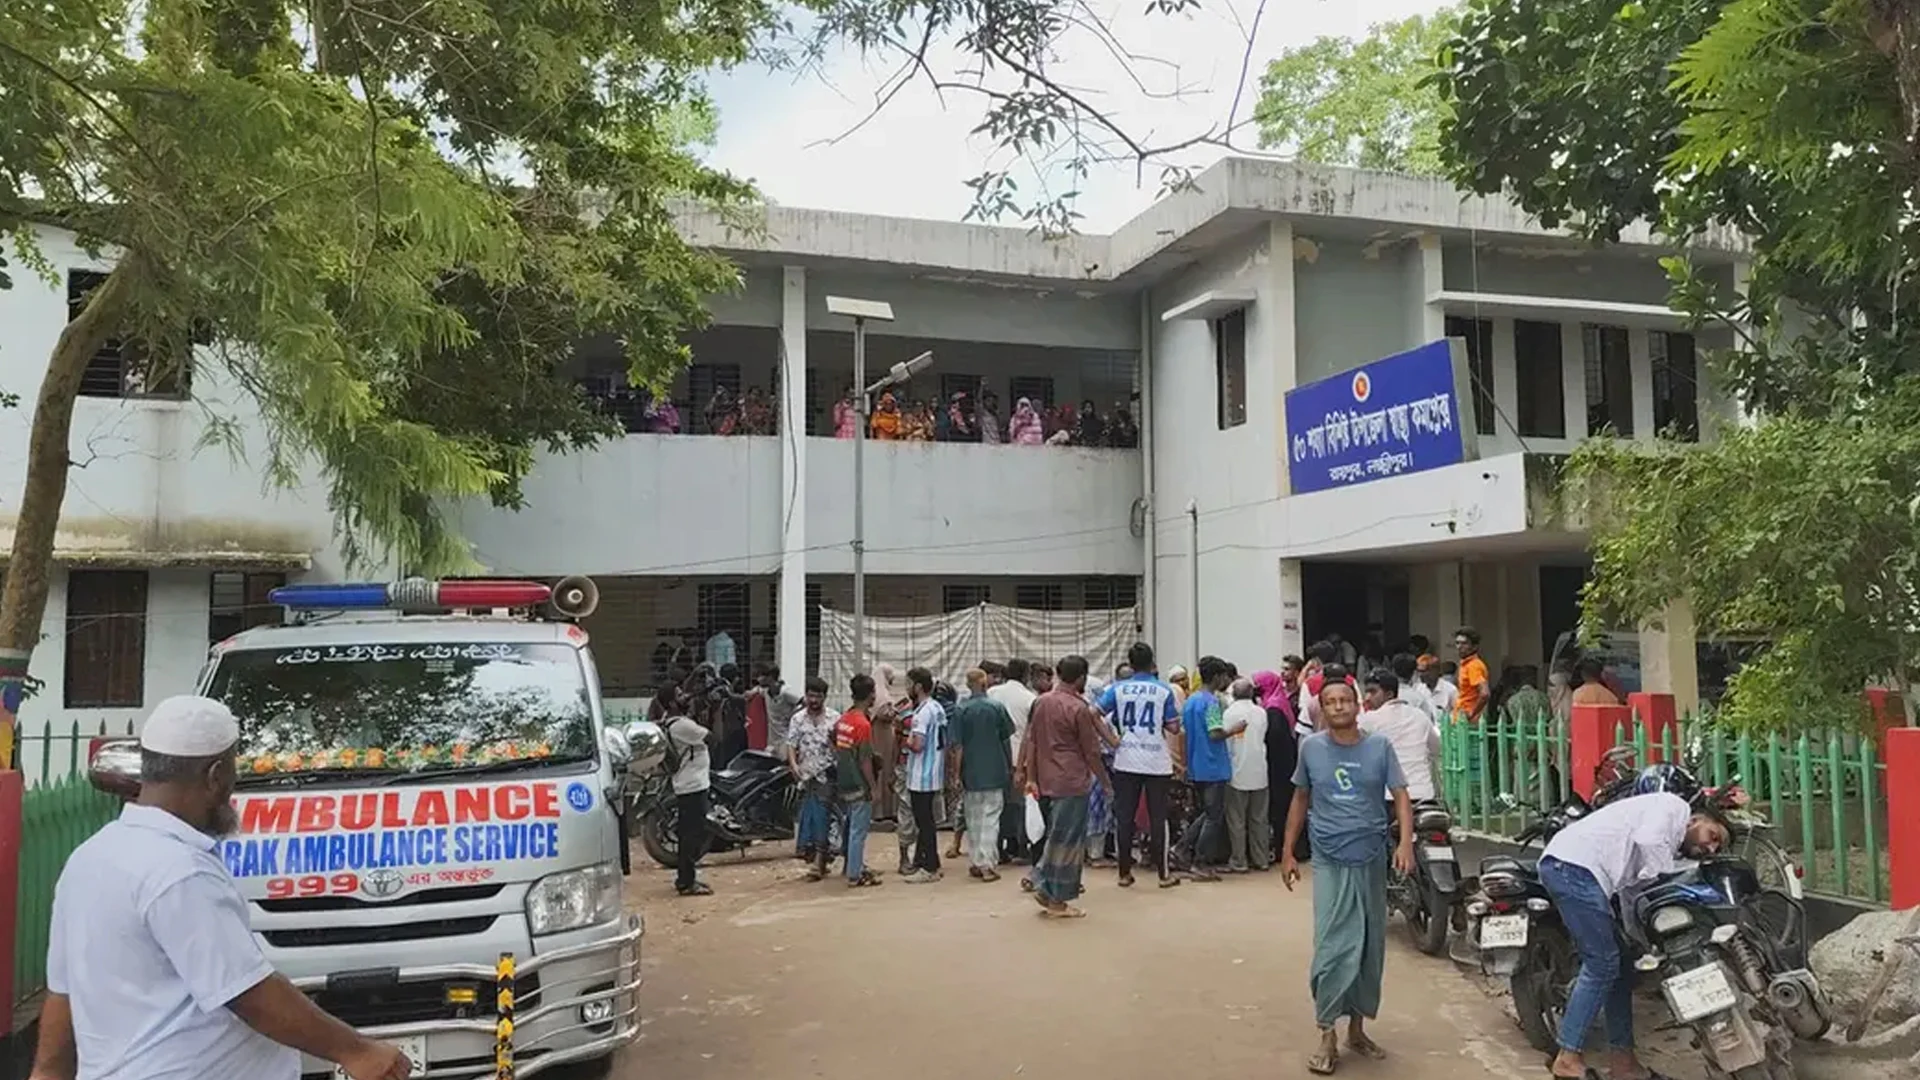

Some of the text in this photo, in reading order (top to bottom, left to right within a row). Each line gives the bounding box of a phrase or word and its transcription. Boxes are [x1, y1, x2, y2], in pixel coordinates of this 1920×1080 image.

[1349, 408, 1388, 447] উপজেলা
[1123, 701, 1156, 735] 44
[230, 783, 561, 834] MBULANCE
[217, 822, 559, 878] RAK AMBULANCE SERVICE
[266, 873, 358, 899] 999
